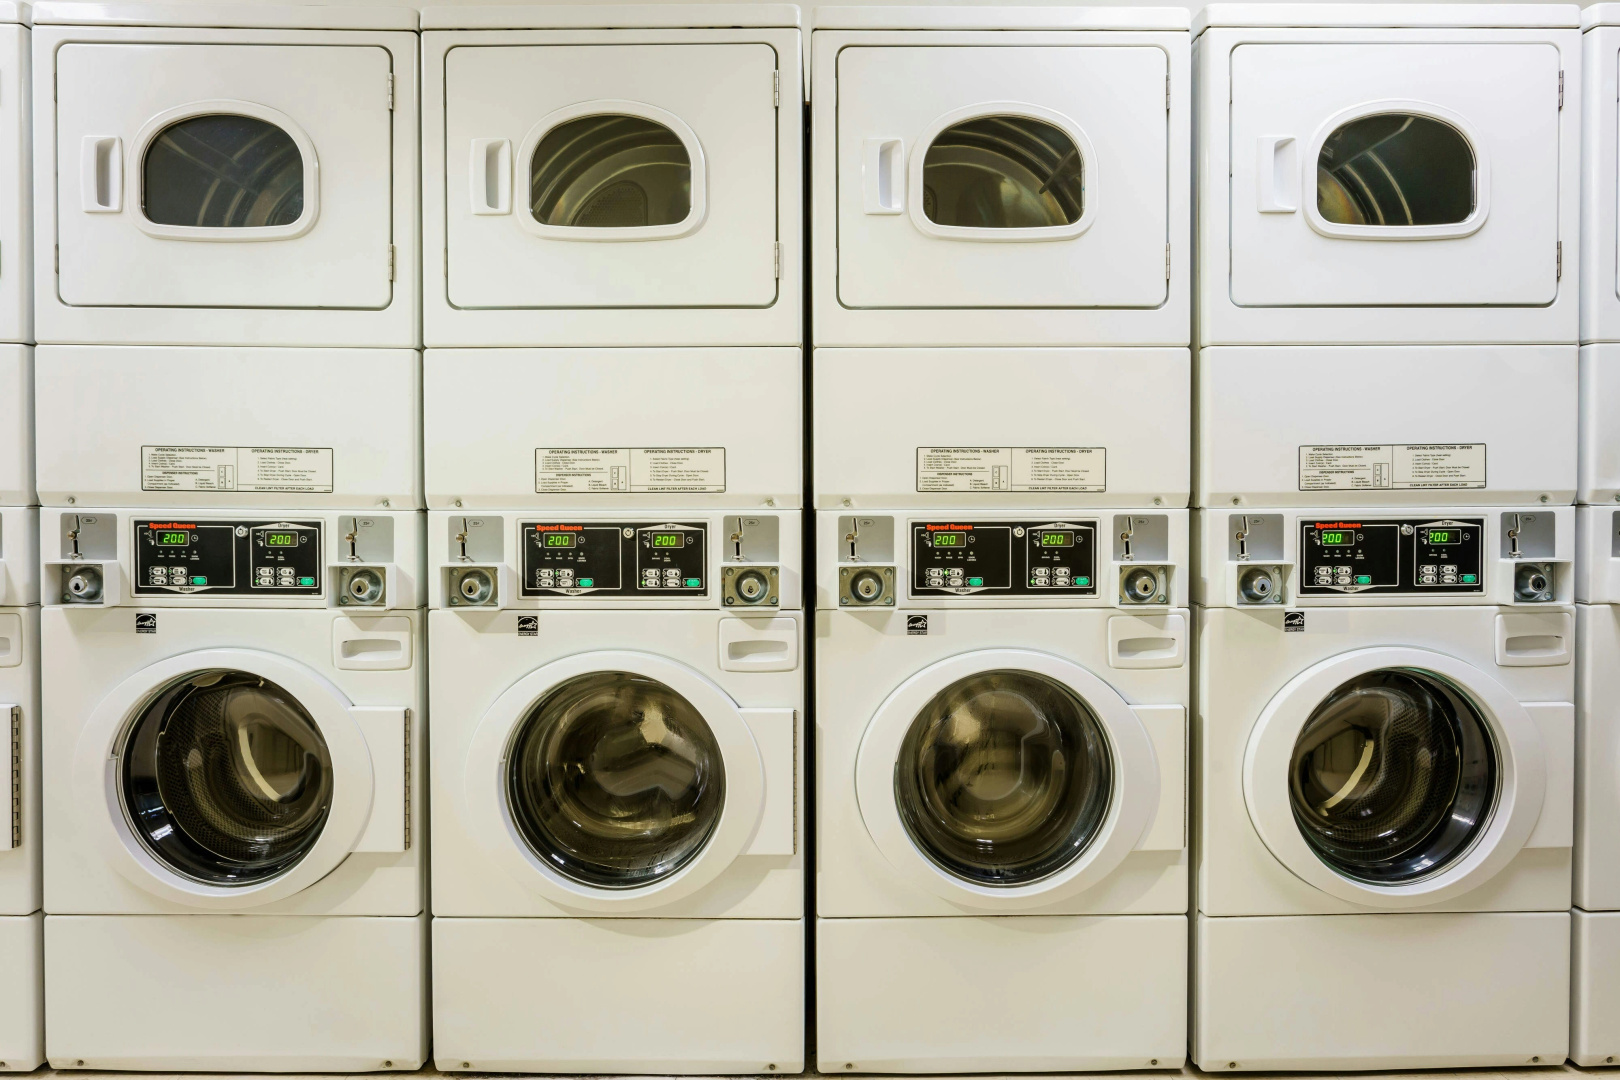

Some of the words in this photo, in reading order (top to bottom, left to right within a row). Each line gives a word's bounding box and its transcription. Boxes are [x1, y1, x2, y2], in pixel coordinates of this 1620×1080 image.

[164, 533, 184, 544] 200
[270, 535, 291, 544] 200
[548, 536, 569, 545] 200
[655, 536, 676, 545] 200
[935, 535, 956, 545] 200
[1042, 535, 1064, 544] 200
